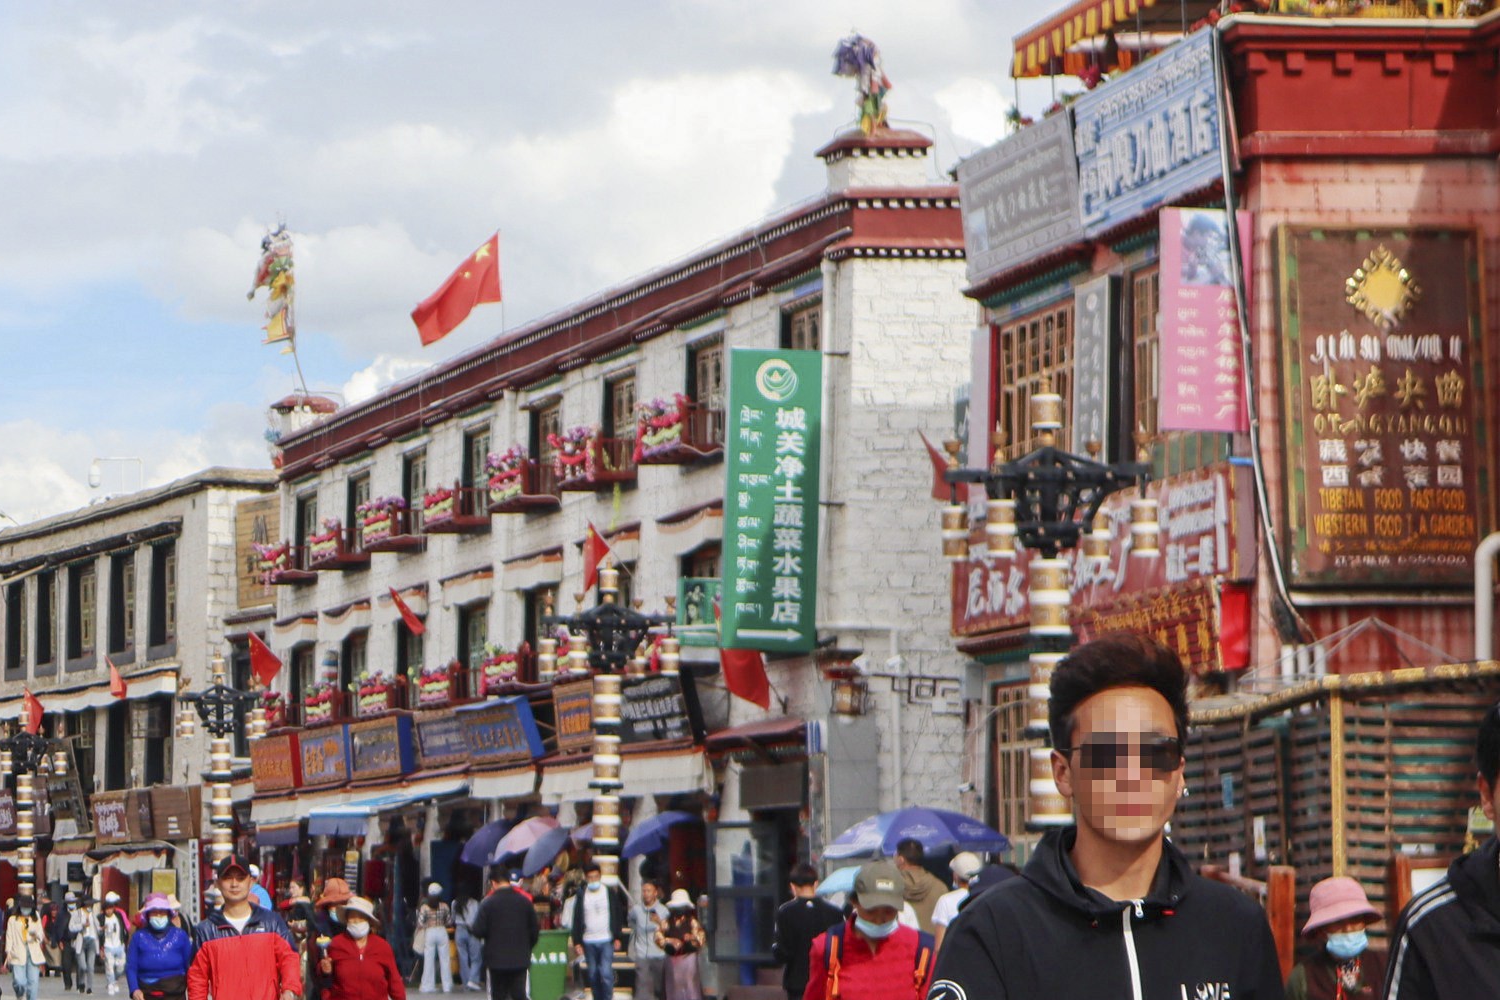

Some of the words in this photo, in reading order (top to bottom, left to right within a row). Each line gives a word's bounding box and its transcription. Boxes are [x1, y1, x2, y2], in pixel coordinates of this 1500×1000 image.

[1318, 487, 1365, 512] TIBETAN
[1374, 487, 1404, 512] FOOD
[770, 406, 807, 625] 城关净土蔬菜水果店
[1313, 512, 1369, 537] WESTERN
[1373, 513, 1403, 537] FOOD
[1430, 514, 1474, 538] GARDEN
